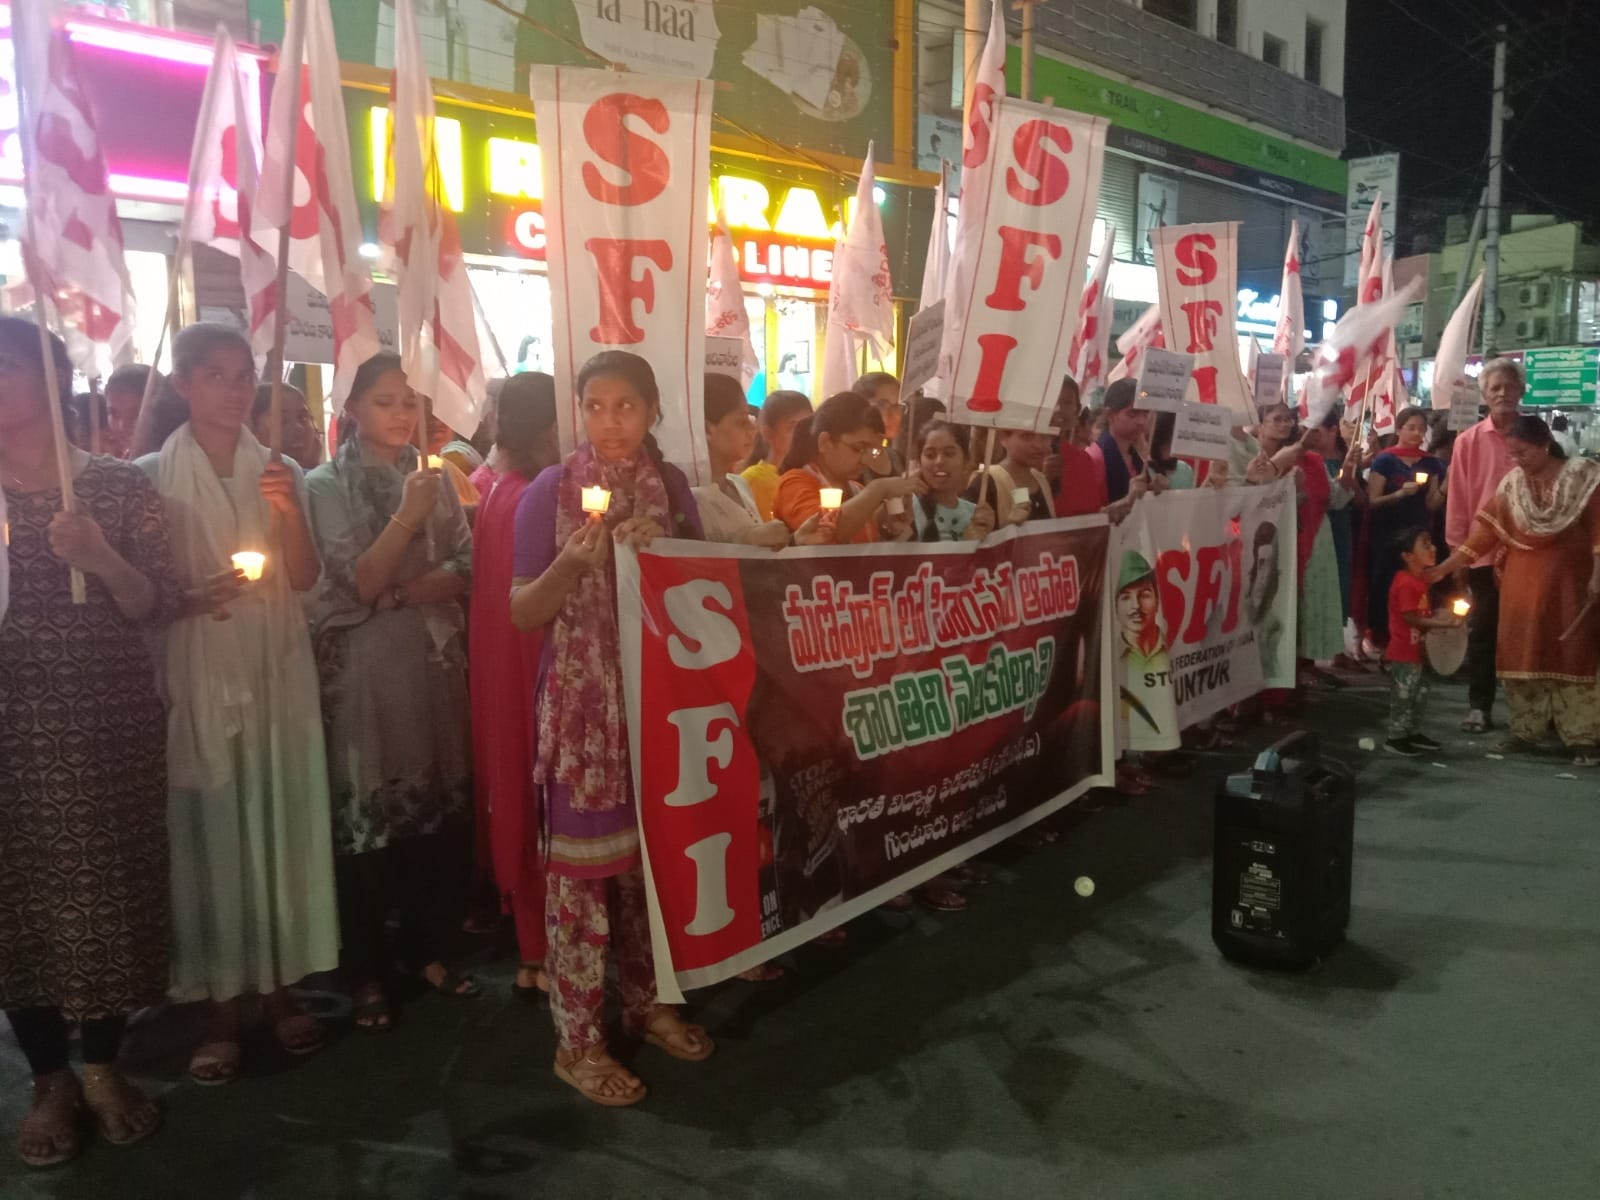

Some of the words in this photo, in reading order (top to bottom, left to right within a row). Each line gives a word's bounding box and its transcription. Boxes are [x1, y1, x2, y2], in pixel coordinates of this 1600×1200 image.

[644, 0, 695, 41] naa
[1157, 540, 1241, 649] SFI
[1173, 659, 1230, 706] UNTUR
[664, 579, 742, 936] SFI
